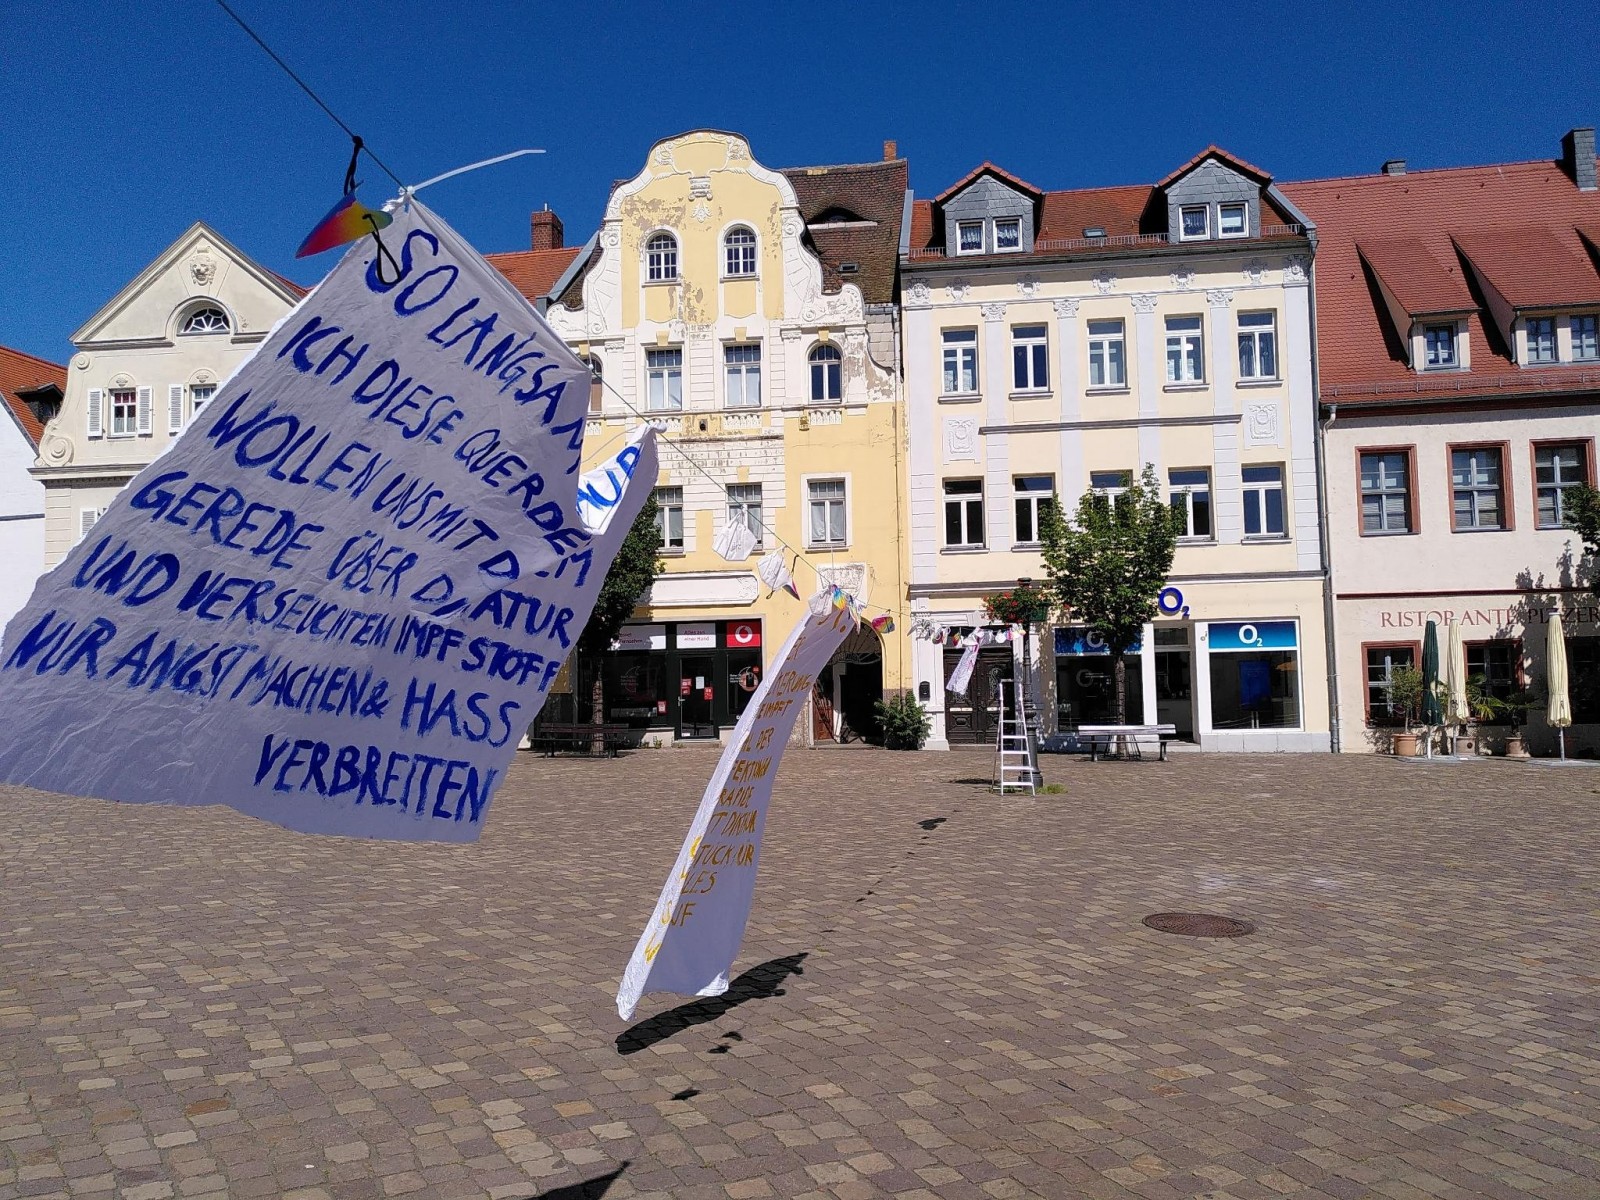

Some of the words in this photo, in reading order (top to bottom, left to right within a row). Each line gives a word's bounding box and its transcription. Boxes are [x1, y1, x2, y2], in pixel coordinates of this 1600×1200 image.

[365, 228, 459, 317] SO
[275, 316, 370, 386] ICH
[351, 358, 464, 445] DIESE
[130, 470, 325, 570] GEREDE
[326, 529, 419, 601] ÜBER
[207, 388, 392, 500] WOLLEN
[479, 548, 593, 588] DM
[71, 534, 180, 607] UND
[2, 609, 117, 679] NUR
[105, 631, 260, 702] ANGST
[401, 677, 521, 748] HASS
[253, 733, 499, 824] VERBREITEN
